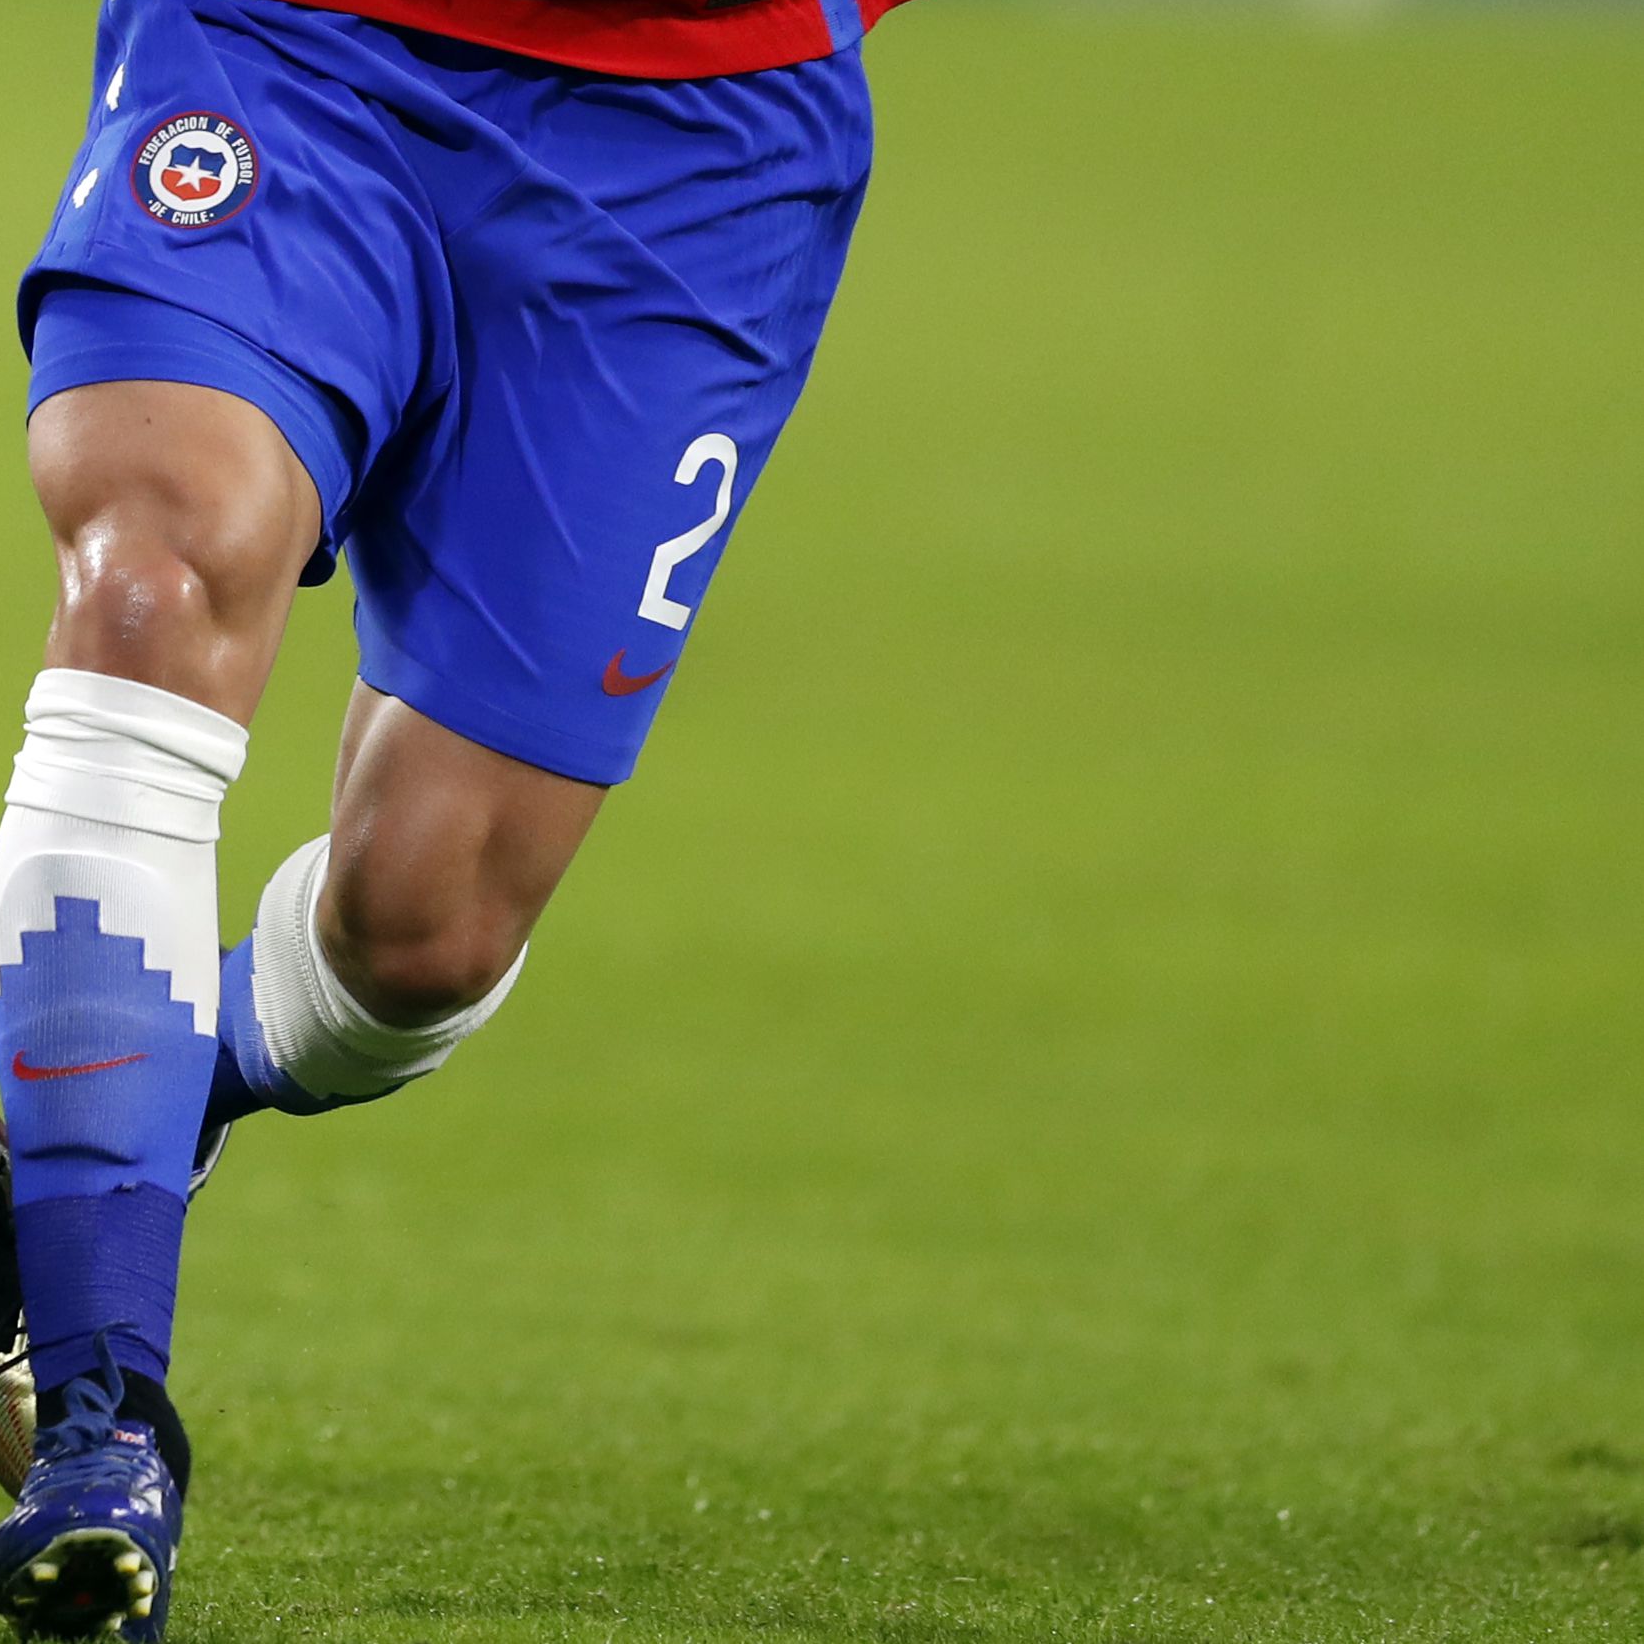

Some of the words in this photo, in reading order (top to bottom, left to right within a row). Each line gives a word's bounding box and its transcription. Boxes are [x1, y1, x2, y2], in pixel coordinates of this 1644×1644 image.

[138, 116, 209, 166] FEDERACION
[214, 121, 234, 140] DE
[231, 137, 254, 185] FUTBOL
[171, 210, 209, 225] CHILE
[637, 432, 738, 631] 2
